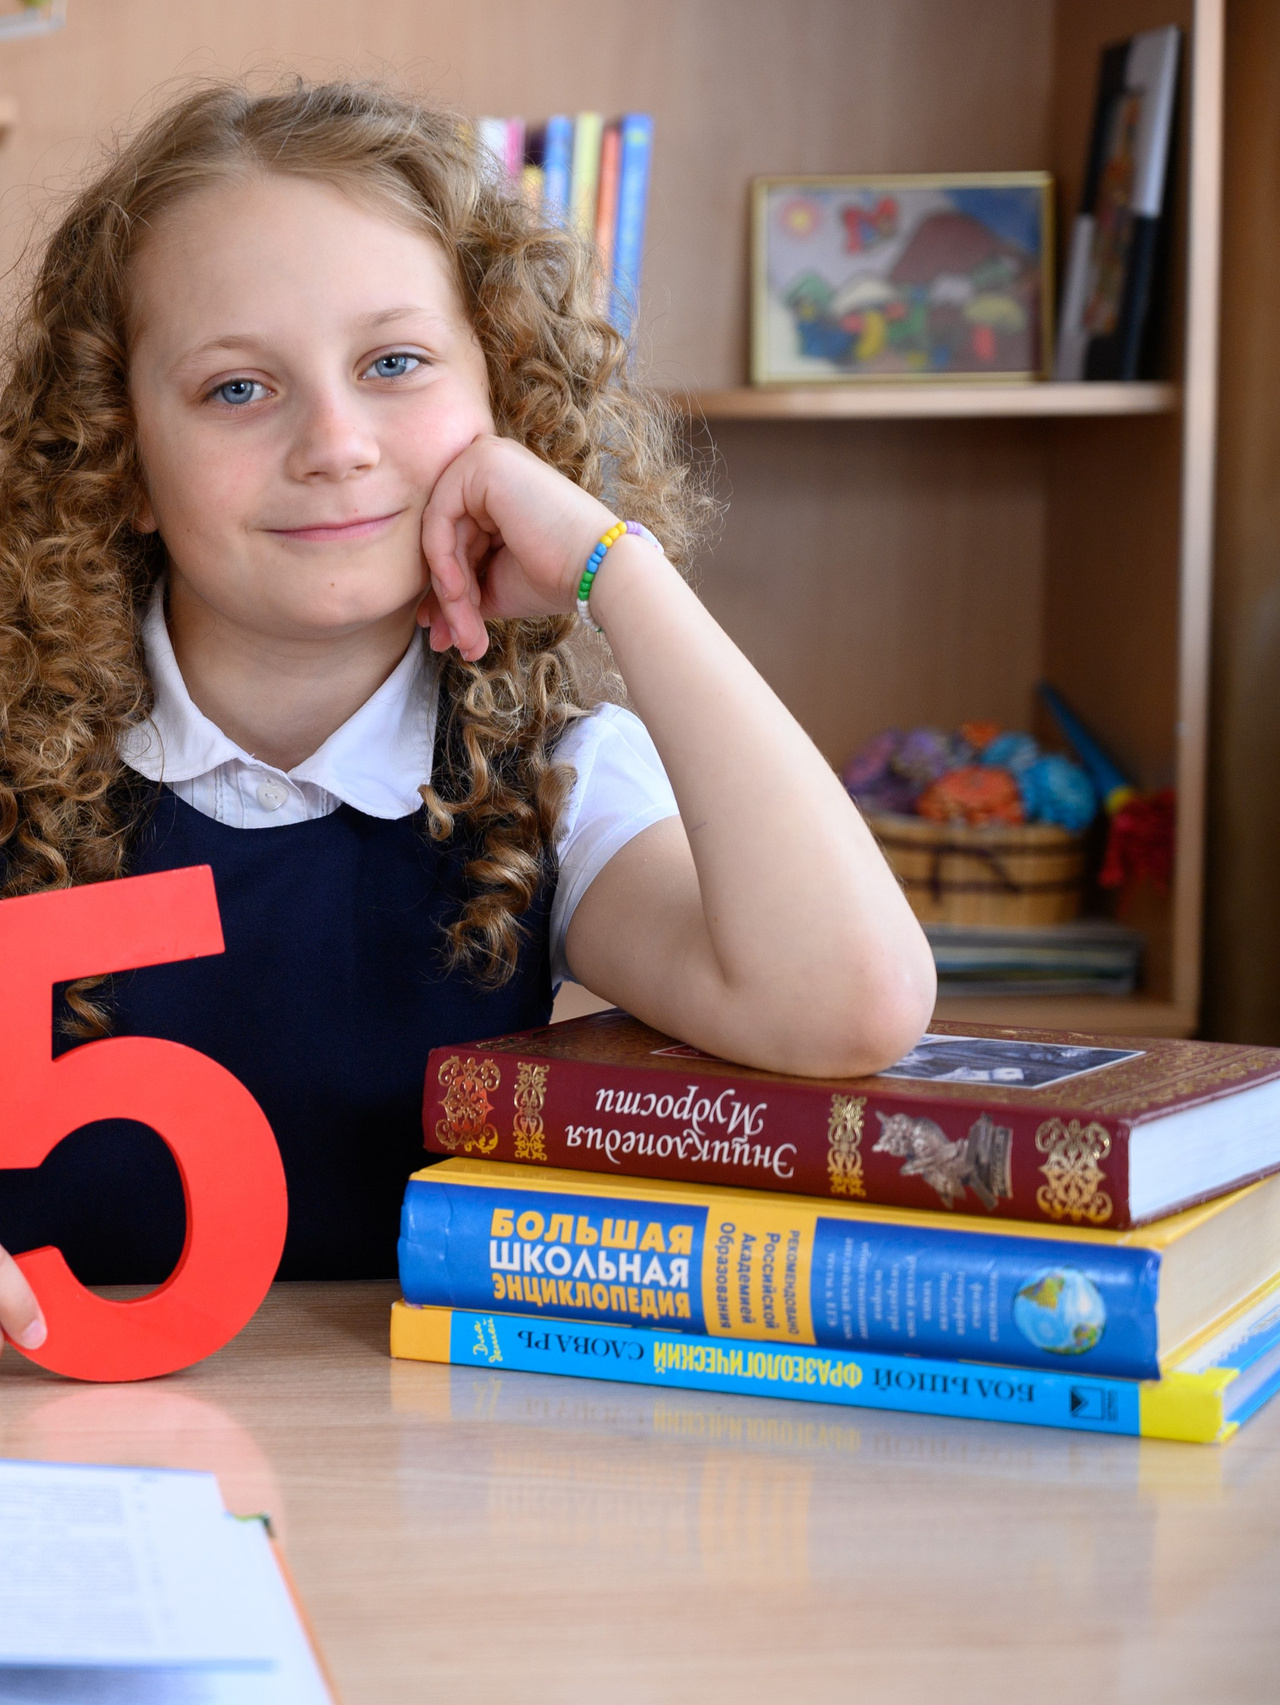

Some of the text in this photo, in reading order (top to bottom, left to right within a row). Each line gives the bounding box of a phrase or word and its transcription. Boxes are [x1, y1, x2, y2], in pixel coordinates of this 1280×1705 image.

[595, 1085, 768, 1136] Мудрости
[565, 1125, 798, 1179] Энциклопедия
[490, 1208, 694, 1255] БОЛЬШАЯ
[489, 1239, 689, 1289] ШКОЛЬНАЯ
[714, 1221, 736, 1330] Образования
[736, 1231, 757, 1325] Академией
[762, 1231, 781, 1330] Российской
[783, 1229, 801, 1336] РЕКОМЕНДОВАНО
[491, 1272, 692, 1320] ЭНЦИКЛОПЕДИЯ
[517, 1330, 1035, 1402] БОЛЬШОЙ ФРАЗЕОЛОГИЧЕСКИЙ СЛОВАРЬ
